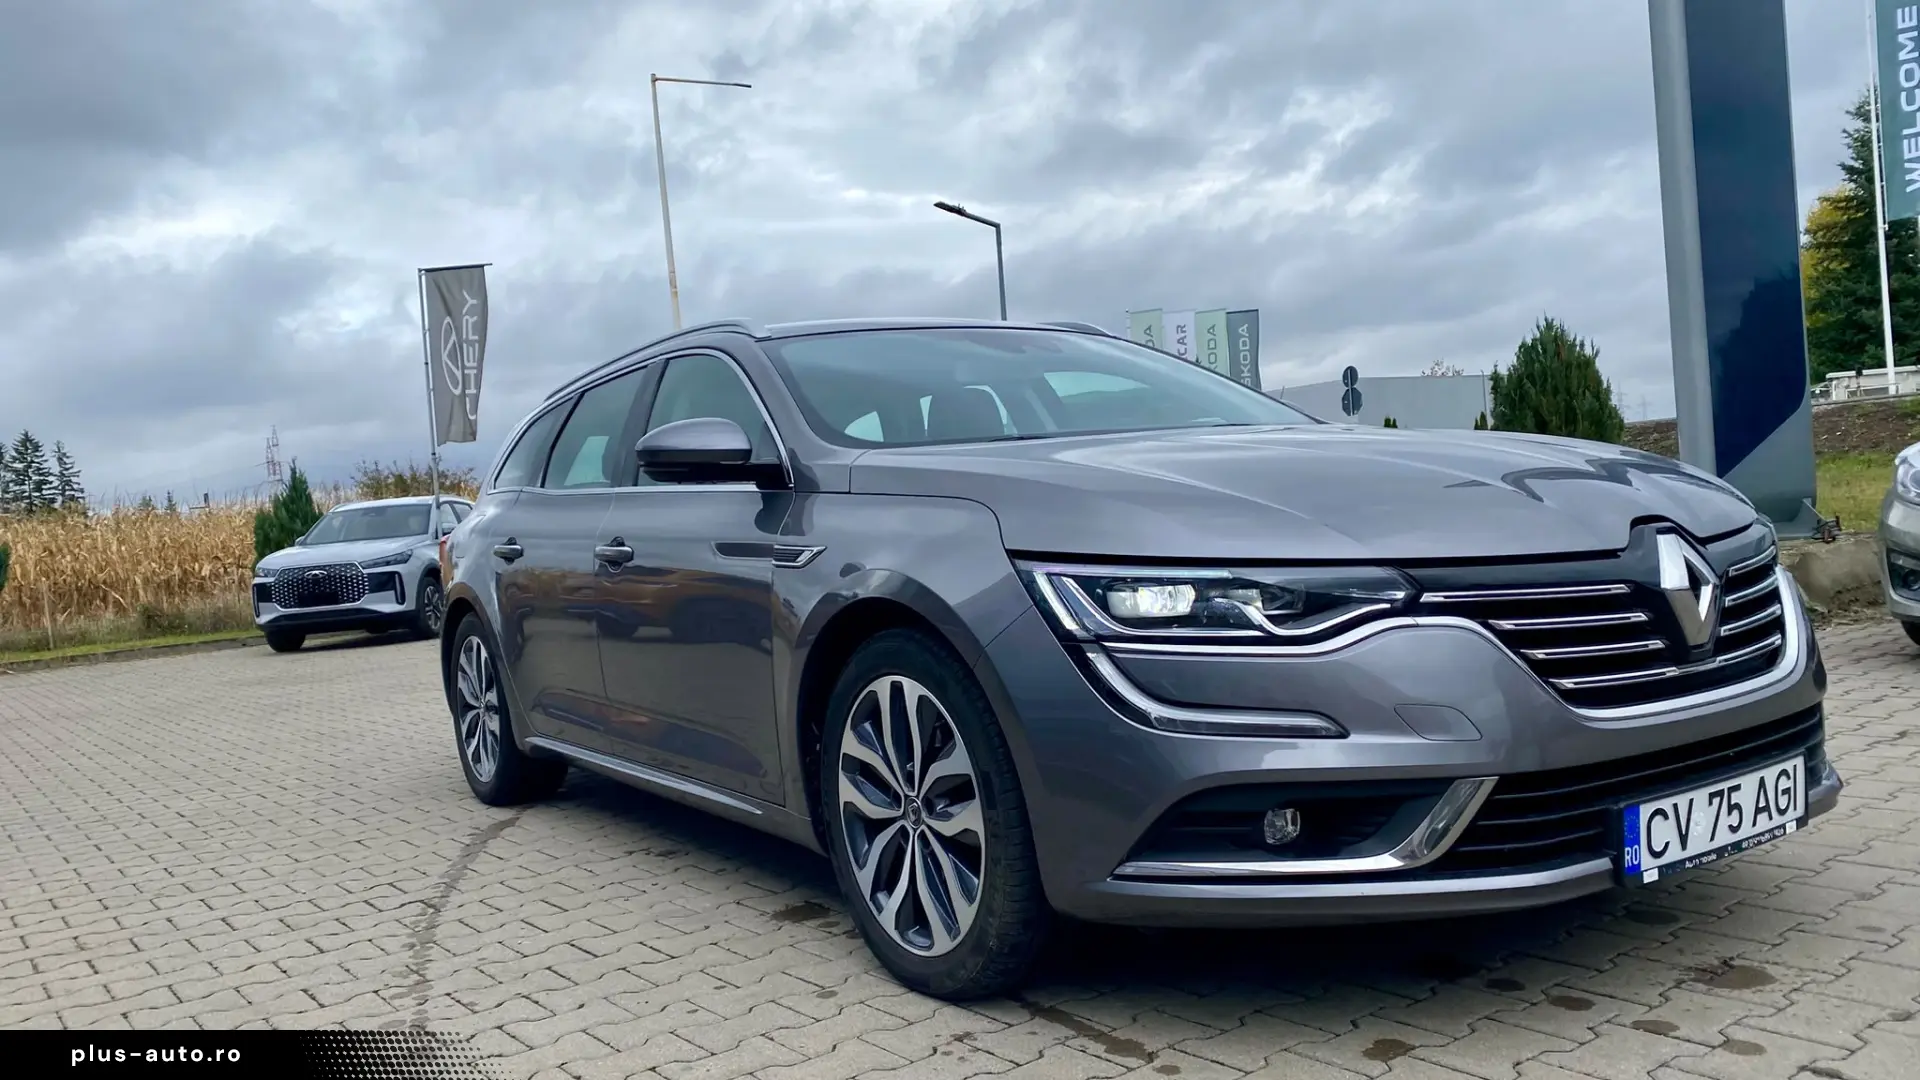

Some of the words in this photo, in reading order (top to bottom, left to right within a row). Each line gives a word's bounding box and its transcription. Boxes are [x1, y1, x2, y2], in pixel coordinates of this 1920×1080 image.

[1896, 4, 1920, 193] WELCOME
[462, 289, 480, 420] CHERY
[1176, 324, 1188, 359] CAR
[1624, 844, 1640, 868] RO
[1646, 797, 1694, 859] CV
[1708, 783, 1743, 842] 75
[1752, 764, 1798, 828] AGI
